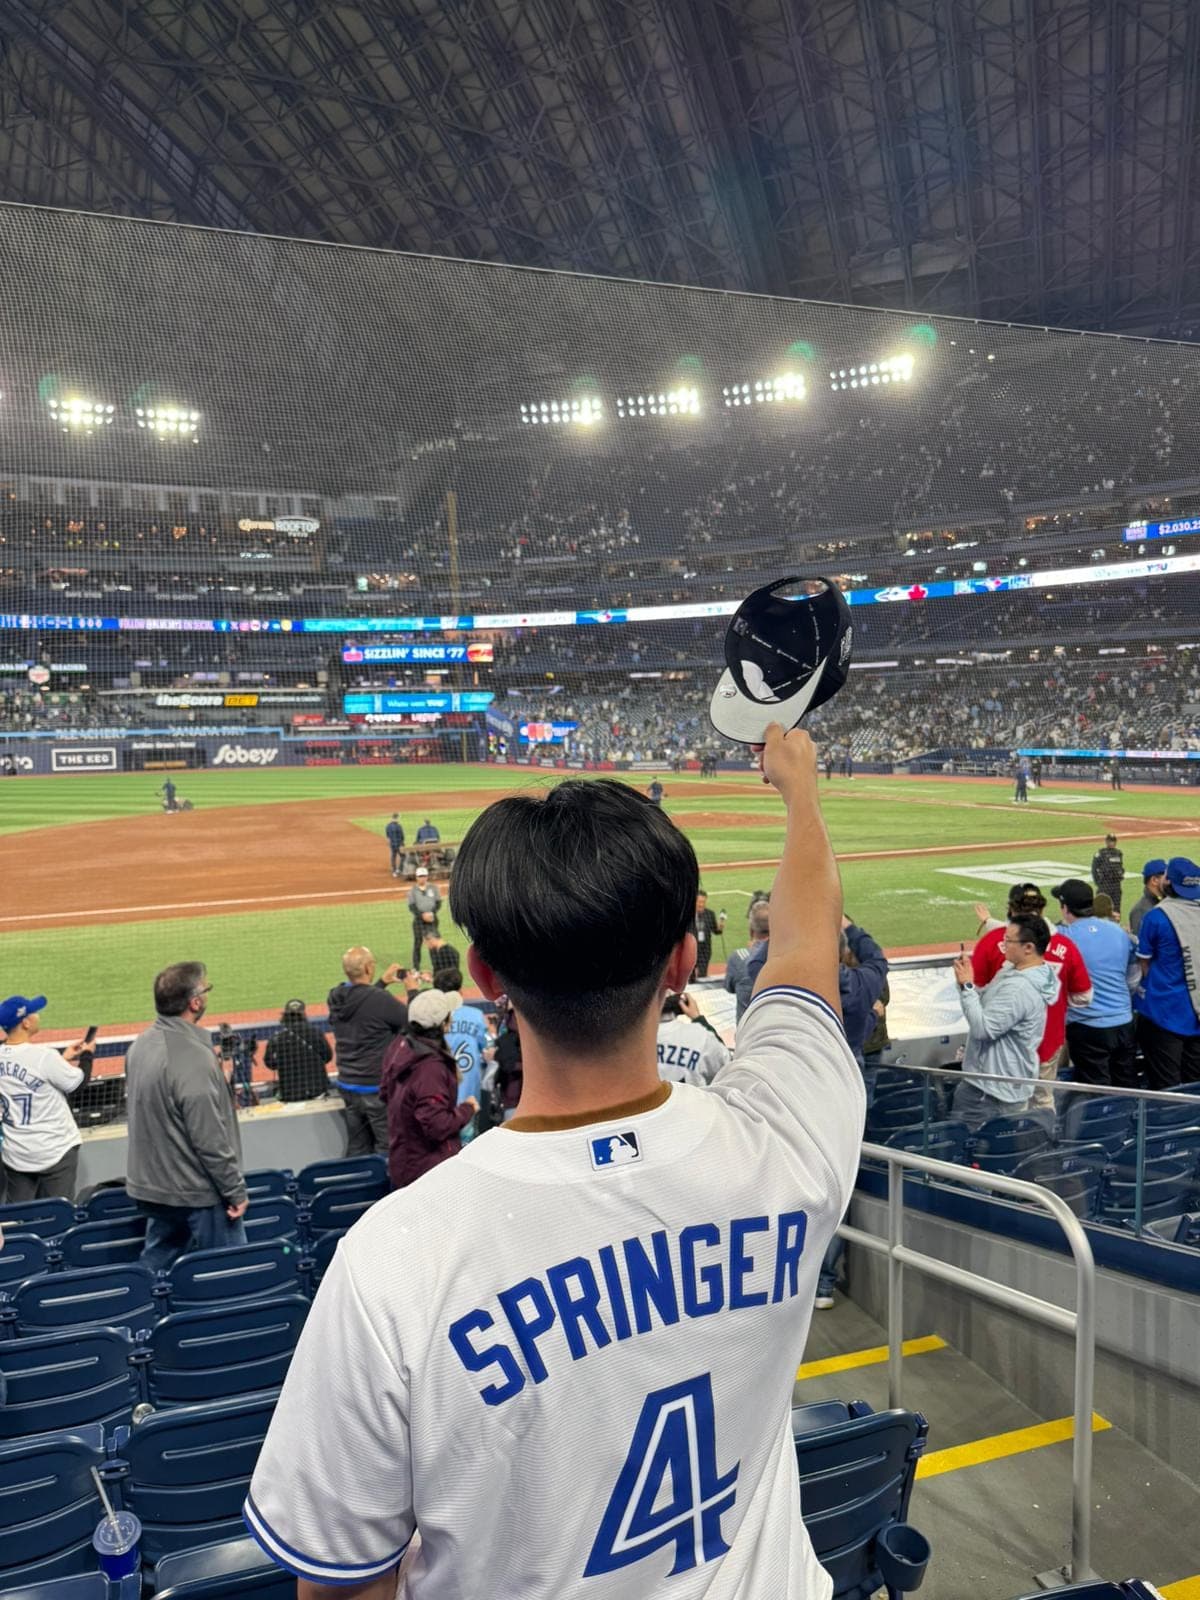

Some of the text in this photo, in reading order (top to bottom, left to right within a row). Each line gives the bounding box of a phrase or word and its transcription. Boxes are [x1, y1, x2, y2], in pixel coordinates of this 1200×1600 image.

[412, 647, 445, 659] SINCE
[156, 694, 224, 706] theScore
[59, 754, 110, 765] THE KEG
[212, 744, 278, 765] Sobeys
[454, 1040, 475, 1074] 6
[448, 1210, 808, 1406] SPRINGER
[583, 1372, 741, 1578] 4
